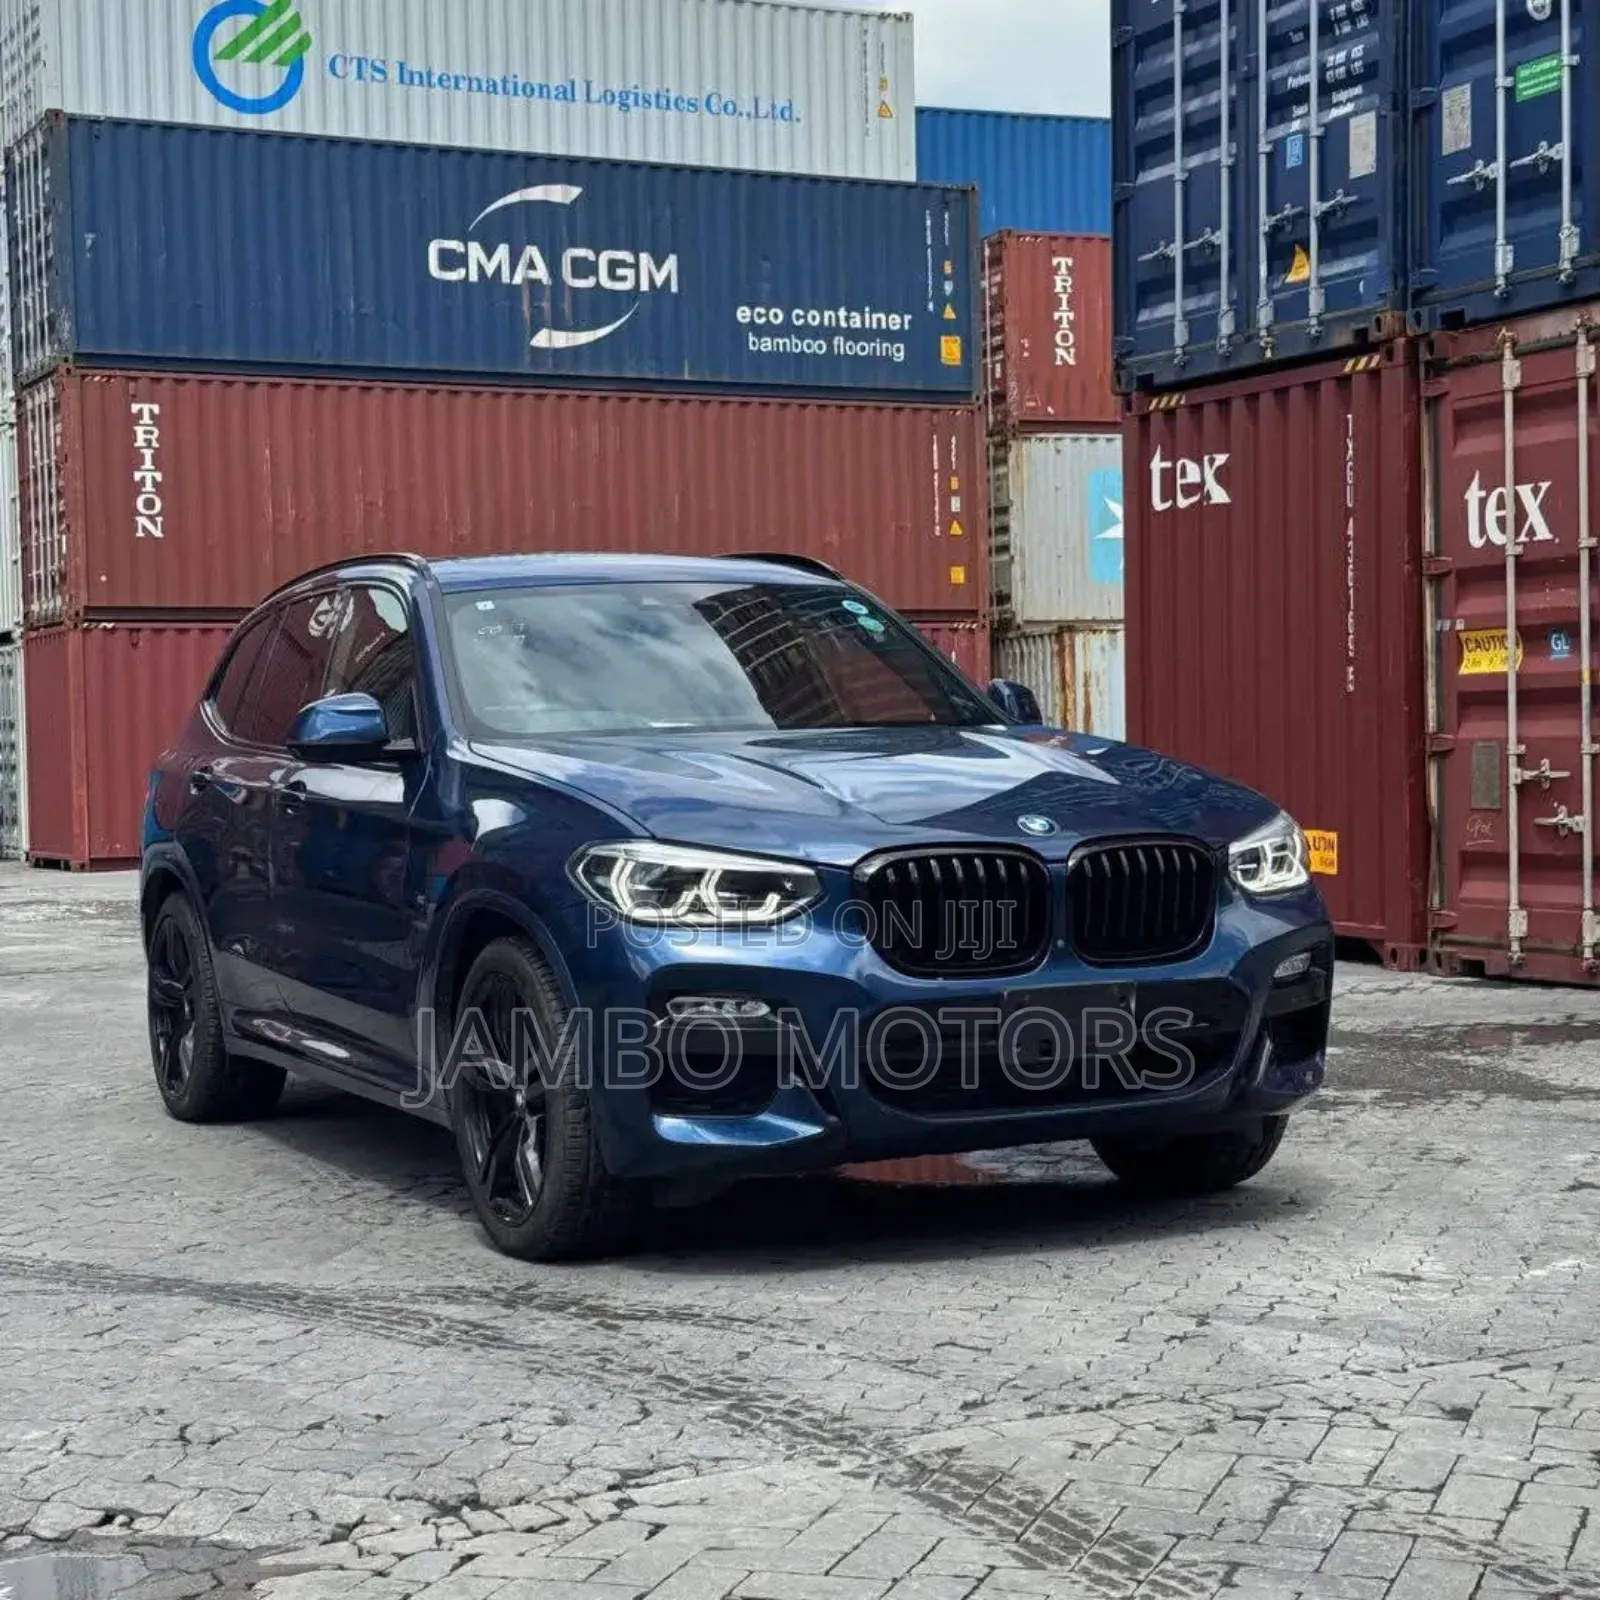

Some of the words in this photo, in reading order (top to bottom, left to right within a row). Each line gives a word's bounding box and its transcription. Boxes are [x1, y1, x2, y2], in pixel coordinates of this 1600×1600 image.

[329, 53, 388, 83] CTS
[396, 60, 576, 102] International
[584, 79, 699, 113] Logistics
[428, 239, 552, 285] CMA
[562, 248, 679, 293] CGM
[736, 305, 784, 325] eco
[791, 306, 912, 331] container
[1052, 256, 1076, 366] TRITON
[748, 332, 827, 354] bamboo
[833, 336, 905, 362] flooring
[131, 403, 164, 538] TRITON
[1150, 443, 1231, 511] tex
[1463, 470, 1553, 548] tex
[1464, 634, 1520, 653] CAUTIO
[1550, 632, 1570, 651] GL
